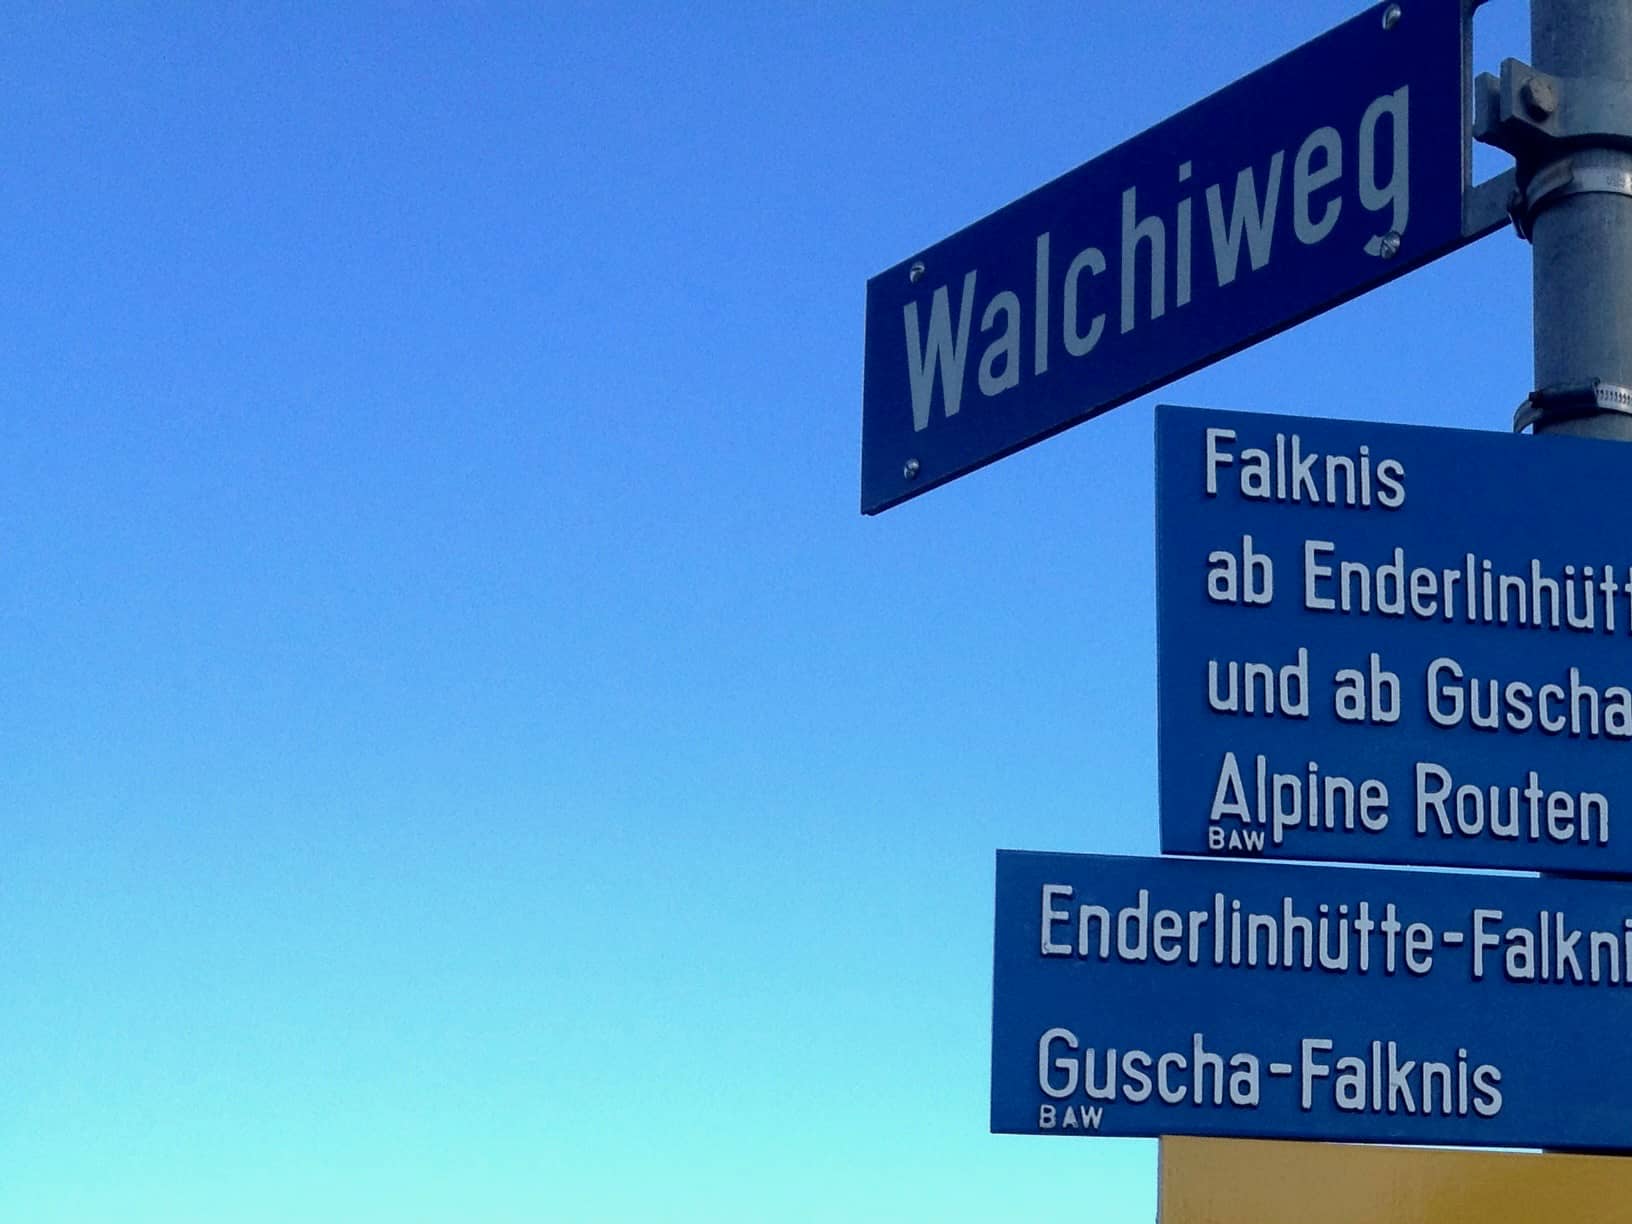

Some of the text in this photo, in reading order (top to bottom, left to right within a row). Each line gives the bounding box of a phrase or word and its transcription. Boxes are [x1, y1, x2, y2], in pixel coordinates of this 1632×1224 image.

[903, 85, 1410, 433] Walchiweg
[1204, 427, 1407, 508] Falknis
[1206, 535, 1274, 604] ab
[1207, 646, 1309, 718] und
[1333, 651, 1402, 724] ab
[1208, 751, 1610, 845] Alpine Routen
[1207, 826, 1267, 853] BAW
[1036, 1026, 1503, 1117] Guscha-Falknis
[1038, 1104, 1104, 1130] BAW
